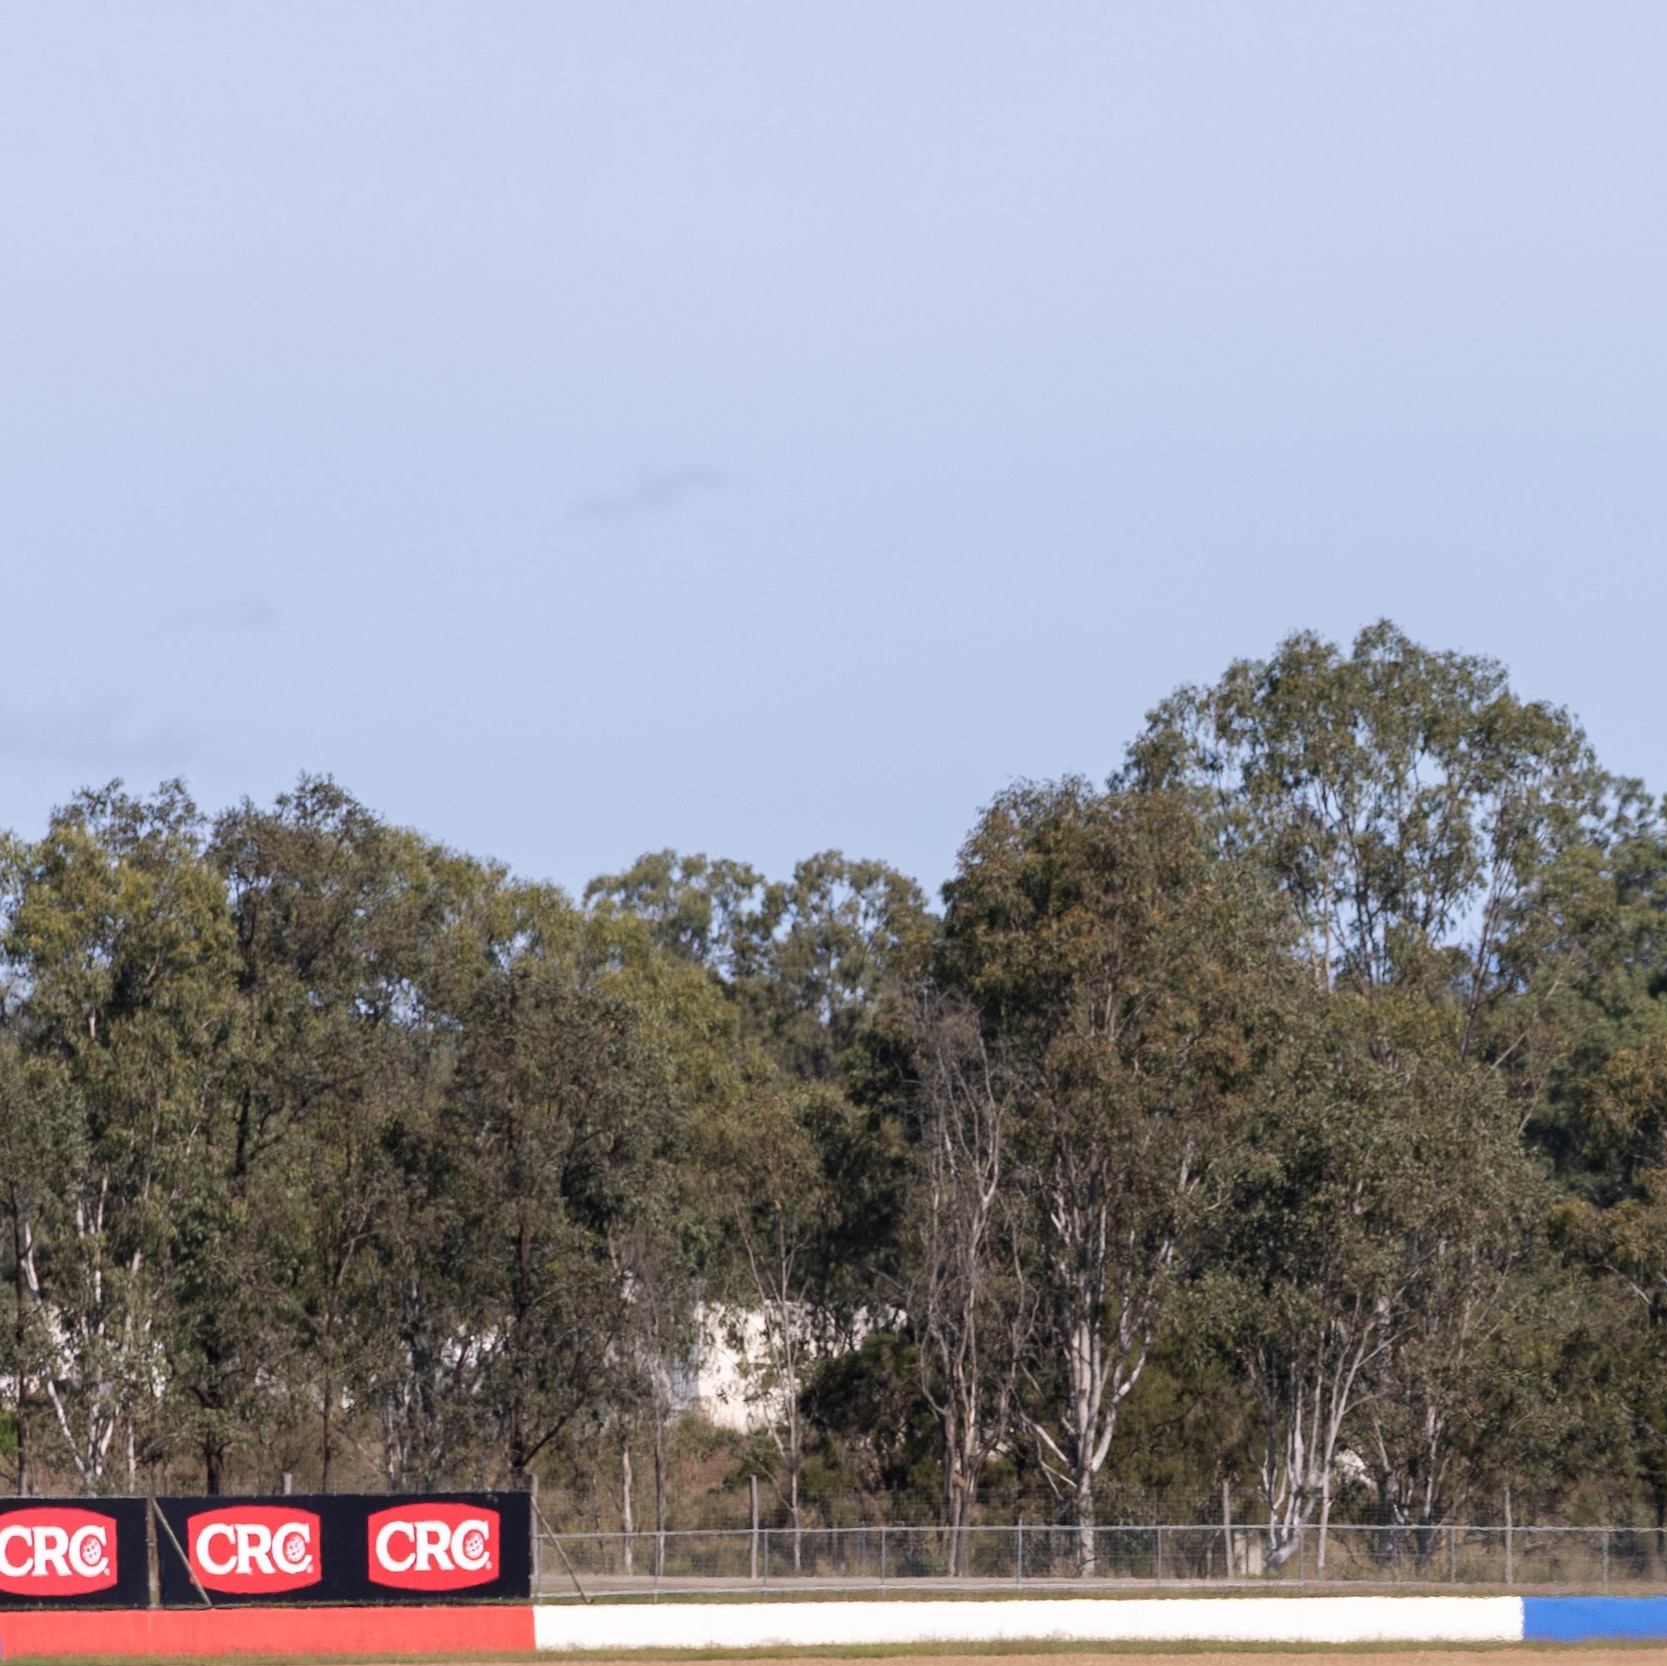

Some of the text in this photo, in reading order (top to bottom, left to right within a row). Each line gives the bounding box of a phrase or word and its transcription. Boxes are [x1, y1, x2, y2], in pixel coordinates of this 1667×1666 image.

[0, 1524, 109, 1578] CRC
[195, 1521, 313, 1575] CRC
[375, 1519, 491, 1573] CRC
